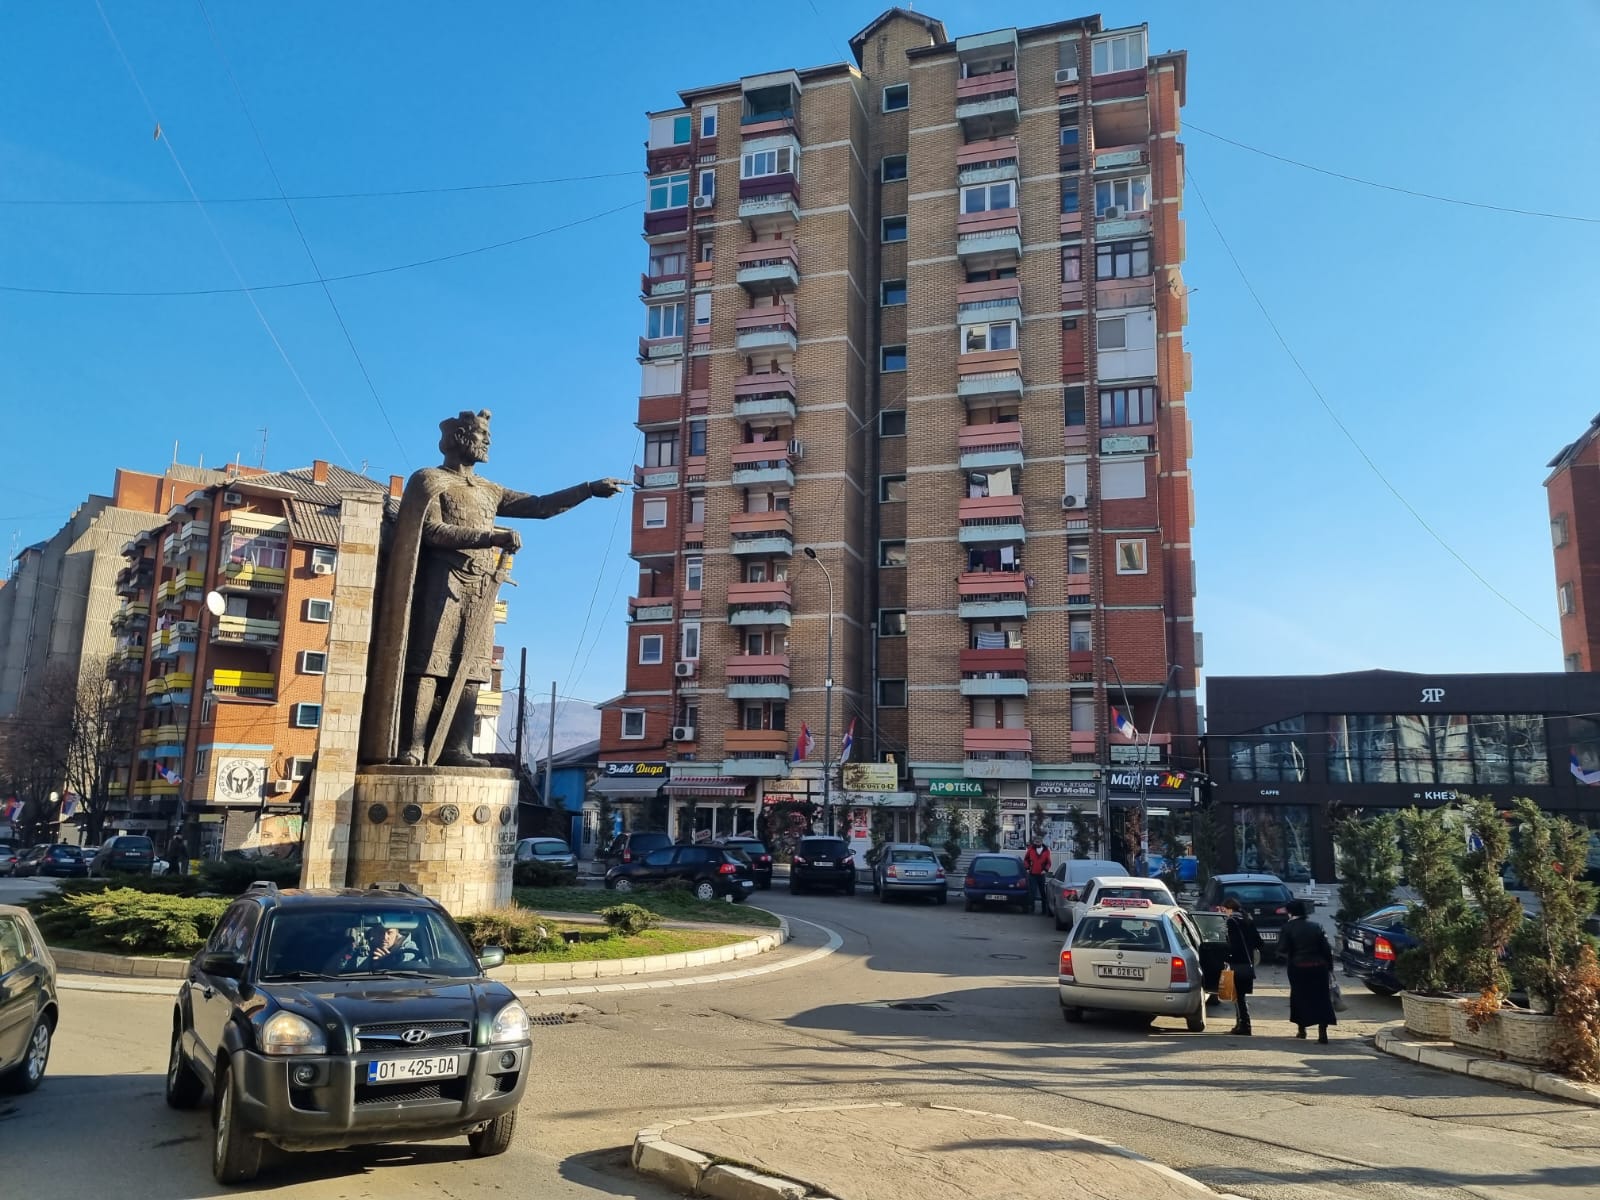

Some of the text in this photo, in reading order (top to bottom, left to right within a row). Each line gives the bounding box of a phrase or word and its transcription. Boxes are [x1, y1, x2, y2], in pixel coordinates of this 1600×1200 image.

[607, 762, 664, 776] Butik Duga
[930, 782, 982, 792] APOTEKA
[379, 1057, 454, 1079] 01 425-DA
